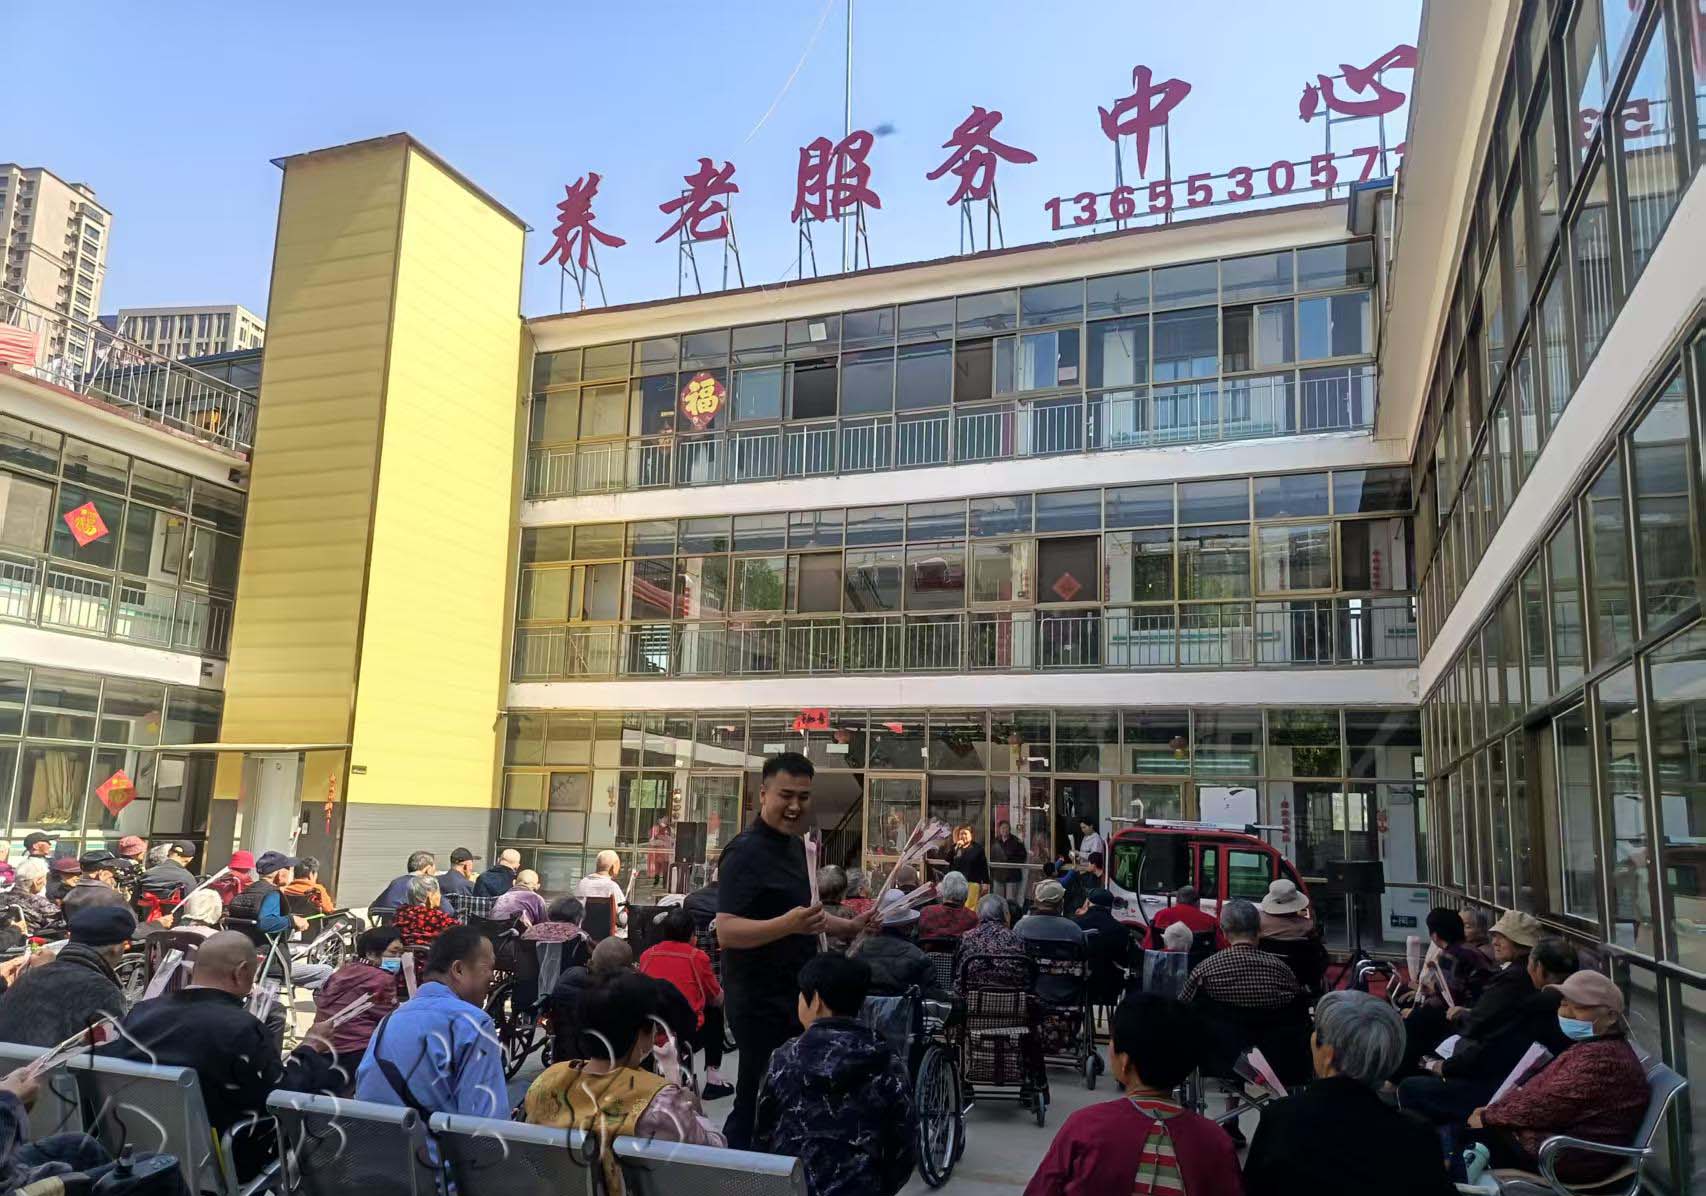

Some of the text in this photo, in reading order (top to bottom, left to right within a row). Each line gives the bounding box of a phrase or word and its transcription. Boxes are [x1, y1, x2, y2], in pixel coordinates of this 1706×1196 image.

[538, 44, 1418, 269] 养老服务中心
[685, 377, 719, 416] 福
